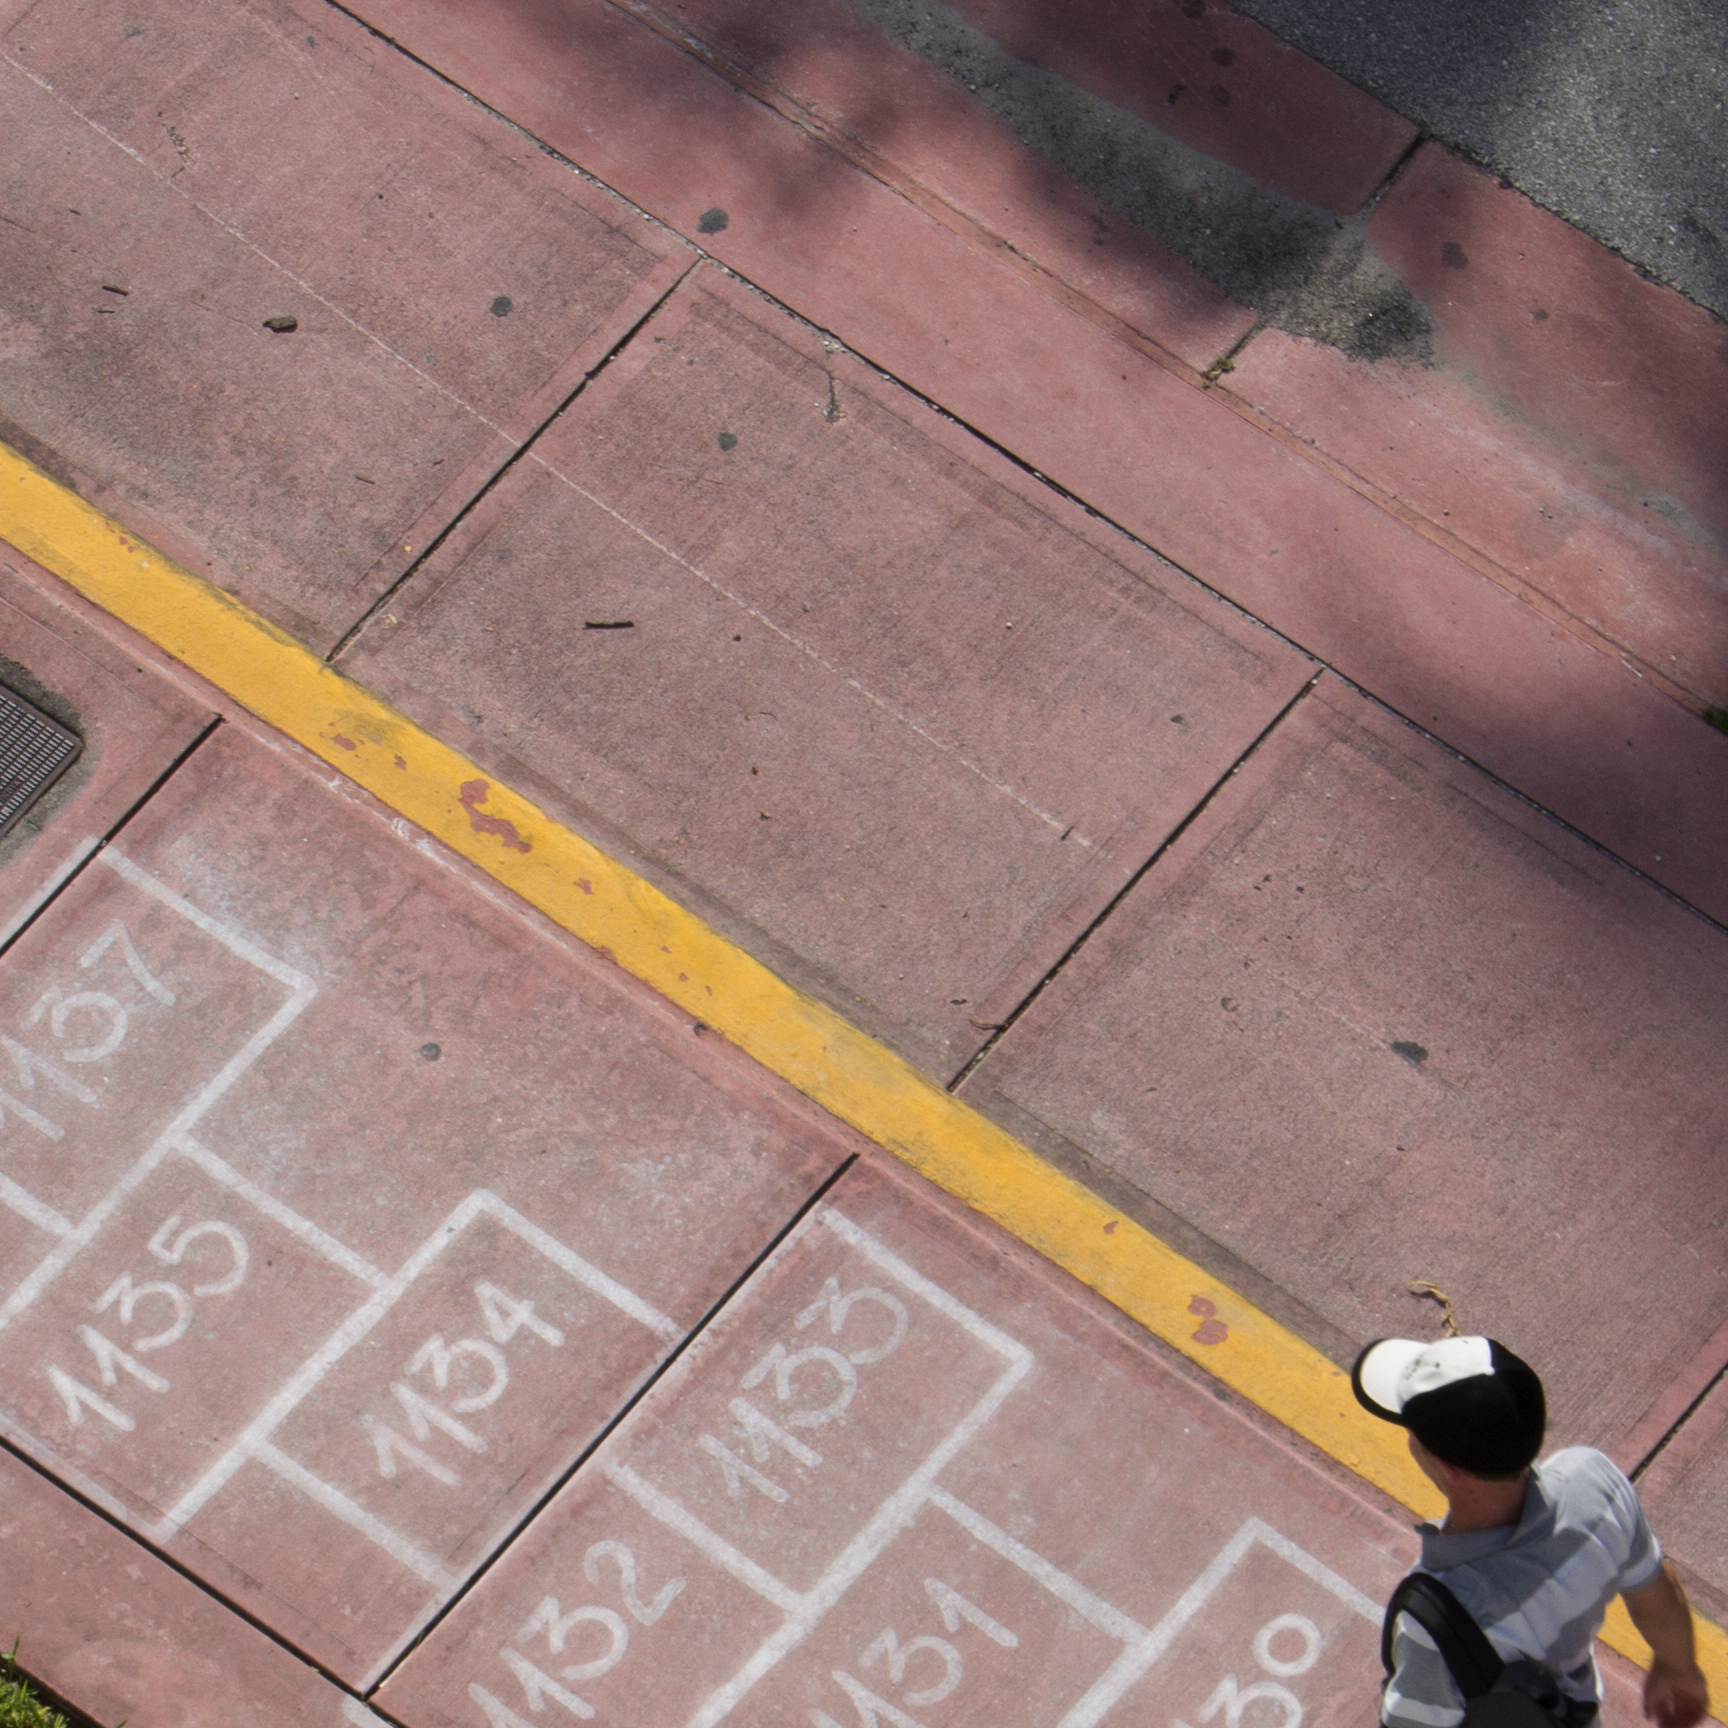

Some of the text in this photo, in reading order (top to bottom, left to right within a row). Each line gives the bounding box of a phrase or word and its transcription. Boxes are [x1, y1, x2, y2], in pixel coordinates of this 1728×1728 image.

[50, 1216, 249, 1431] 1135
[363, 1281, 563, 1487] 1134
[700, 1277, 908, 1503] 1133
